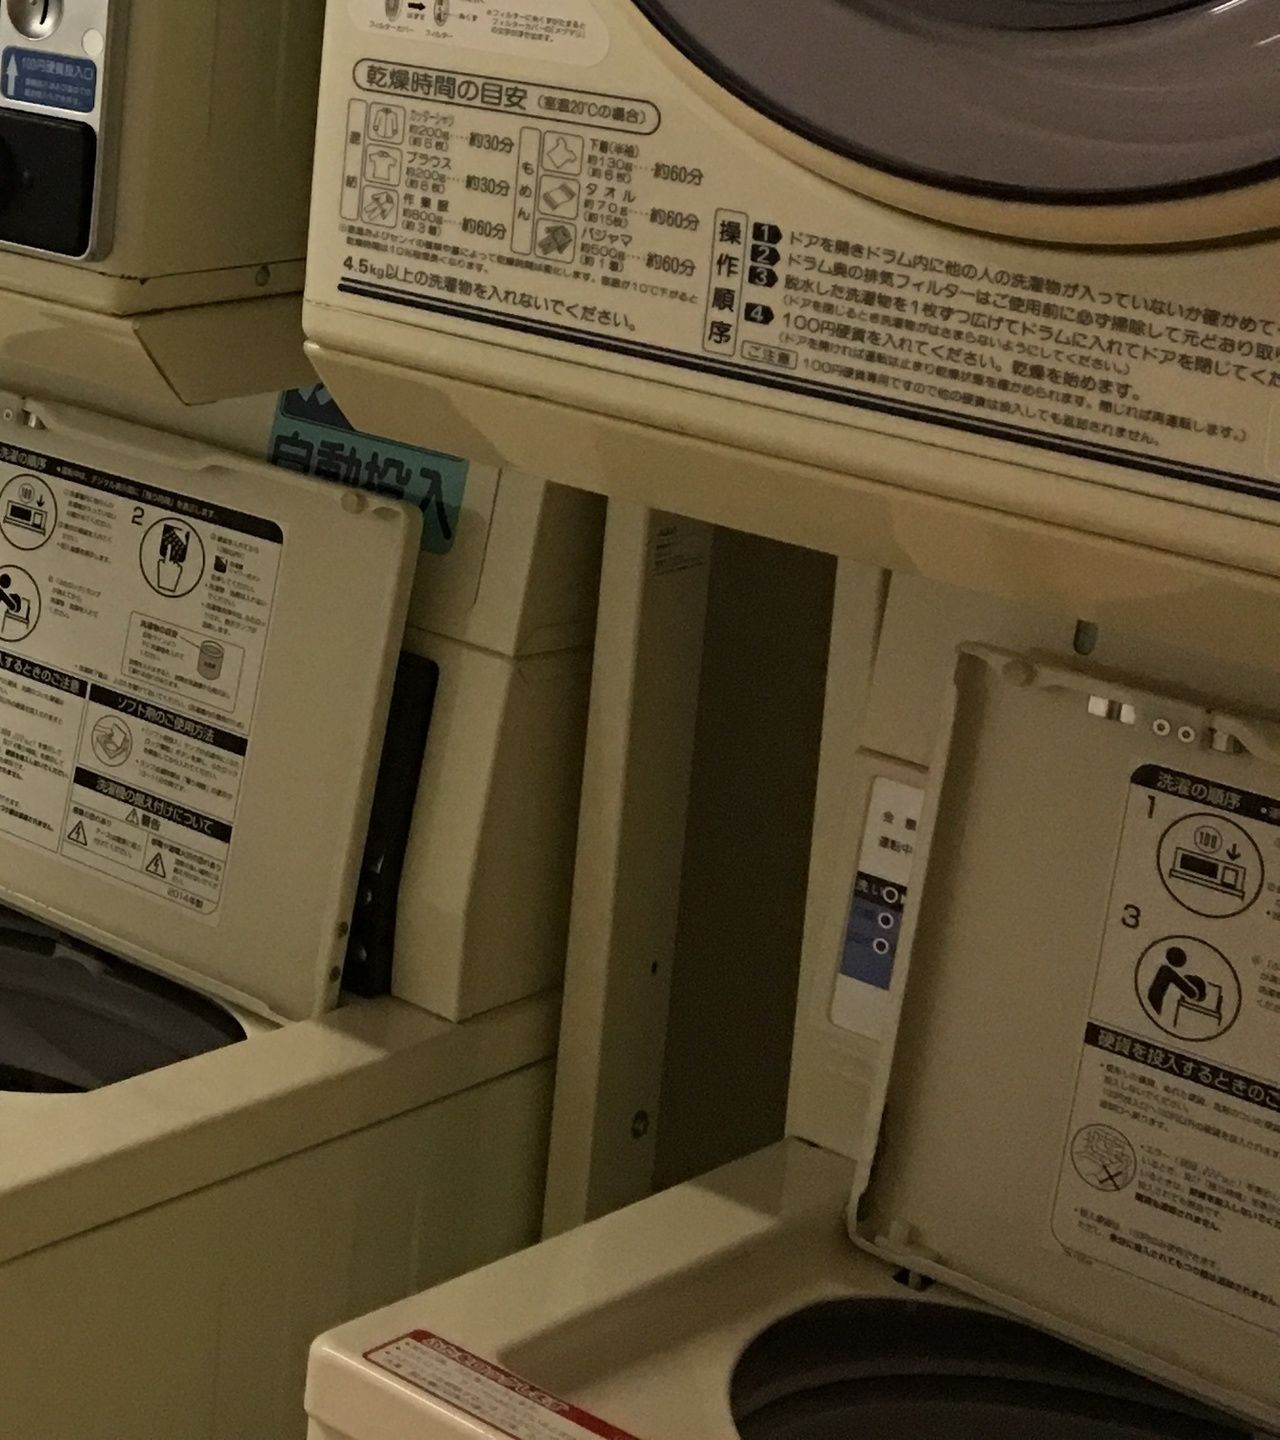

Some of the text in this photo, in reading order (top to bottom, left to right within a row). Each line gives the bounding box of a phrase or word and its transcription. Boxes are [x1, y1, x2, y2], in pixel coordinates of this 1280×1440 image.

[366, 65, 528, 110] 乾燥時間の目安
[469, 131, 515, 155] 約30分
[405, 150, 452, 171] ブラウス
[465, 174, 511, 197] 約30分
[653, 162, 704, 186] 約60分
[517, 160, 535, 222] もめん
[461, 216, 507, 240] 約60分
[650, 207, 700, 231] 約60分
[581, 227, 633, 247] パジャマ
[760, 226, 770, 242] 1
[645, 252, 696, 277] 約60分
[757, 247, 770, 264] 2
[707, 218, 743, 345] 操作順序
[755, 269, 768, 286] 3
[343, 256, 636, 332] 4.5kg以上の洗濯物を入れないでください。
[750, 306, 765, 322] 4
[747, 344, 791, 366] ご注意
[130, 505, 146, 526] 2
[1156, 772, 1241, 810] 洗濯の順序
[1146, 795, 1156, 819] 1
[1121, 904, 1140, 929] 3
